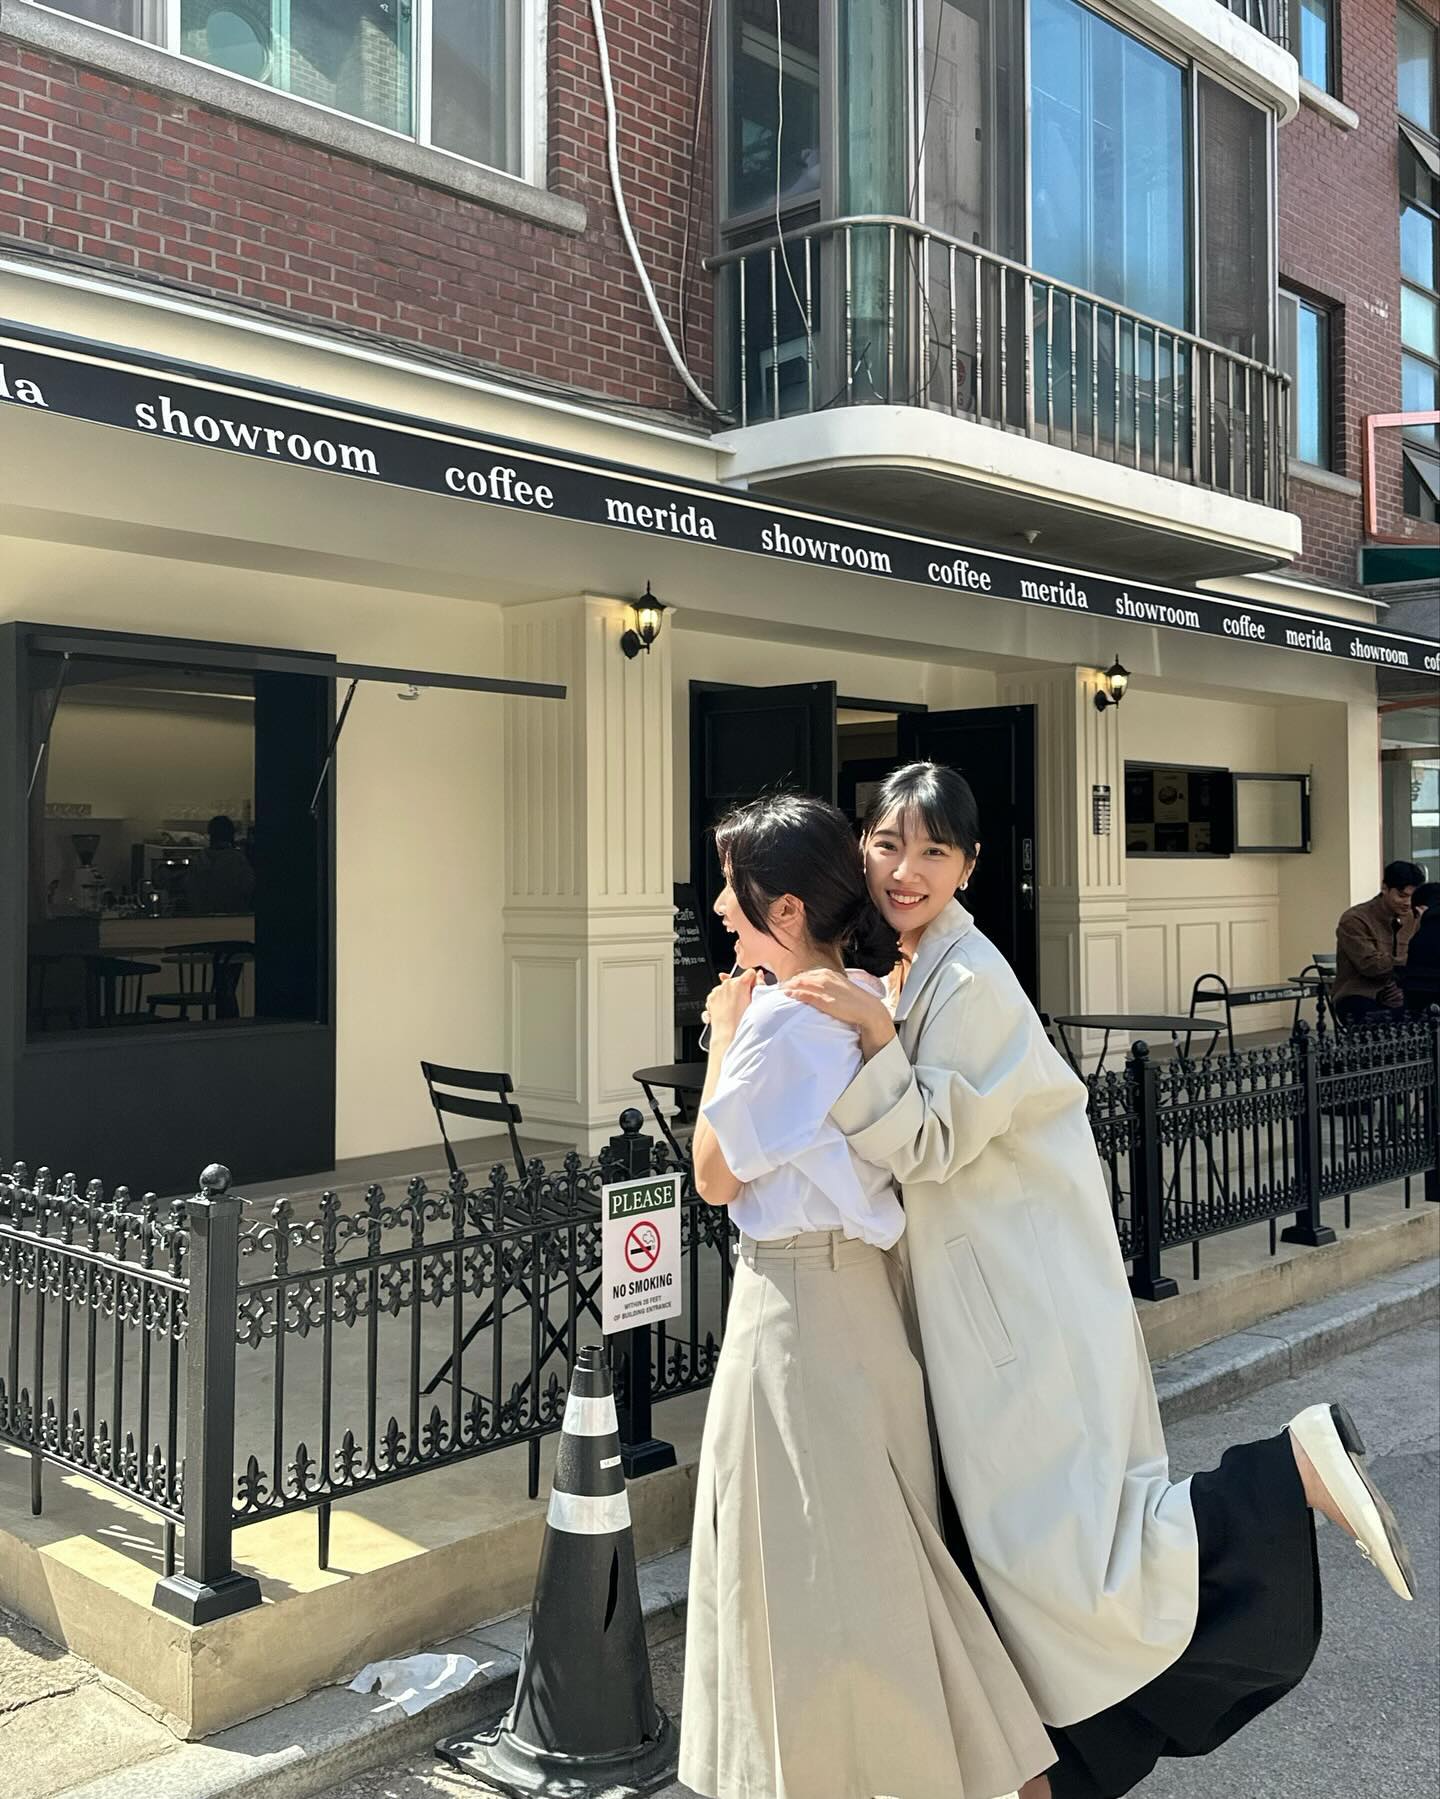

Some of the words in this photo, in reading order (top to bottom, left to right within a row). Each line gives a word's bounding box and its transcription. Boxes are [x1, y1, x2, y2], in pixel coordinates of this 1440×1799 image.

[135, 395, 381, 477] showroom
[445, 466, 554, 509] coffee
[604, 498, 717, 541] merida
[761, 523, 893, 574] showroom
[927, 559, 992, 591] coffee
[1020, 579, 1089, 609] merida
[1115, 592, 1201, 629] showroom
[1222, 614, 1266, 640] coffee
[1285, 629, 1333, 653] merida
[1350, 637, 1409, 666] showroom
[612, 1185, 673, 1214] PLEASE
[613, 1283, 626, 1299] NO
[628, 1273, 673, 1295] SMOKING
[613, 1313, 621, 1322] OF
[622, 1308, 645, 1320] BUILDING
[646, 1301, 672, 1315] ENTRANCE
[624, 1299, 642, 1310] WITHIN
[650, 1295, 663, 1305] FEET
